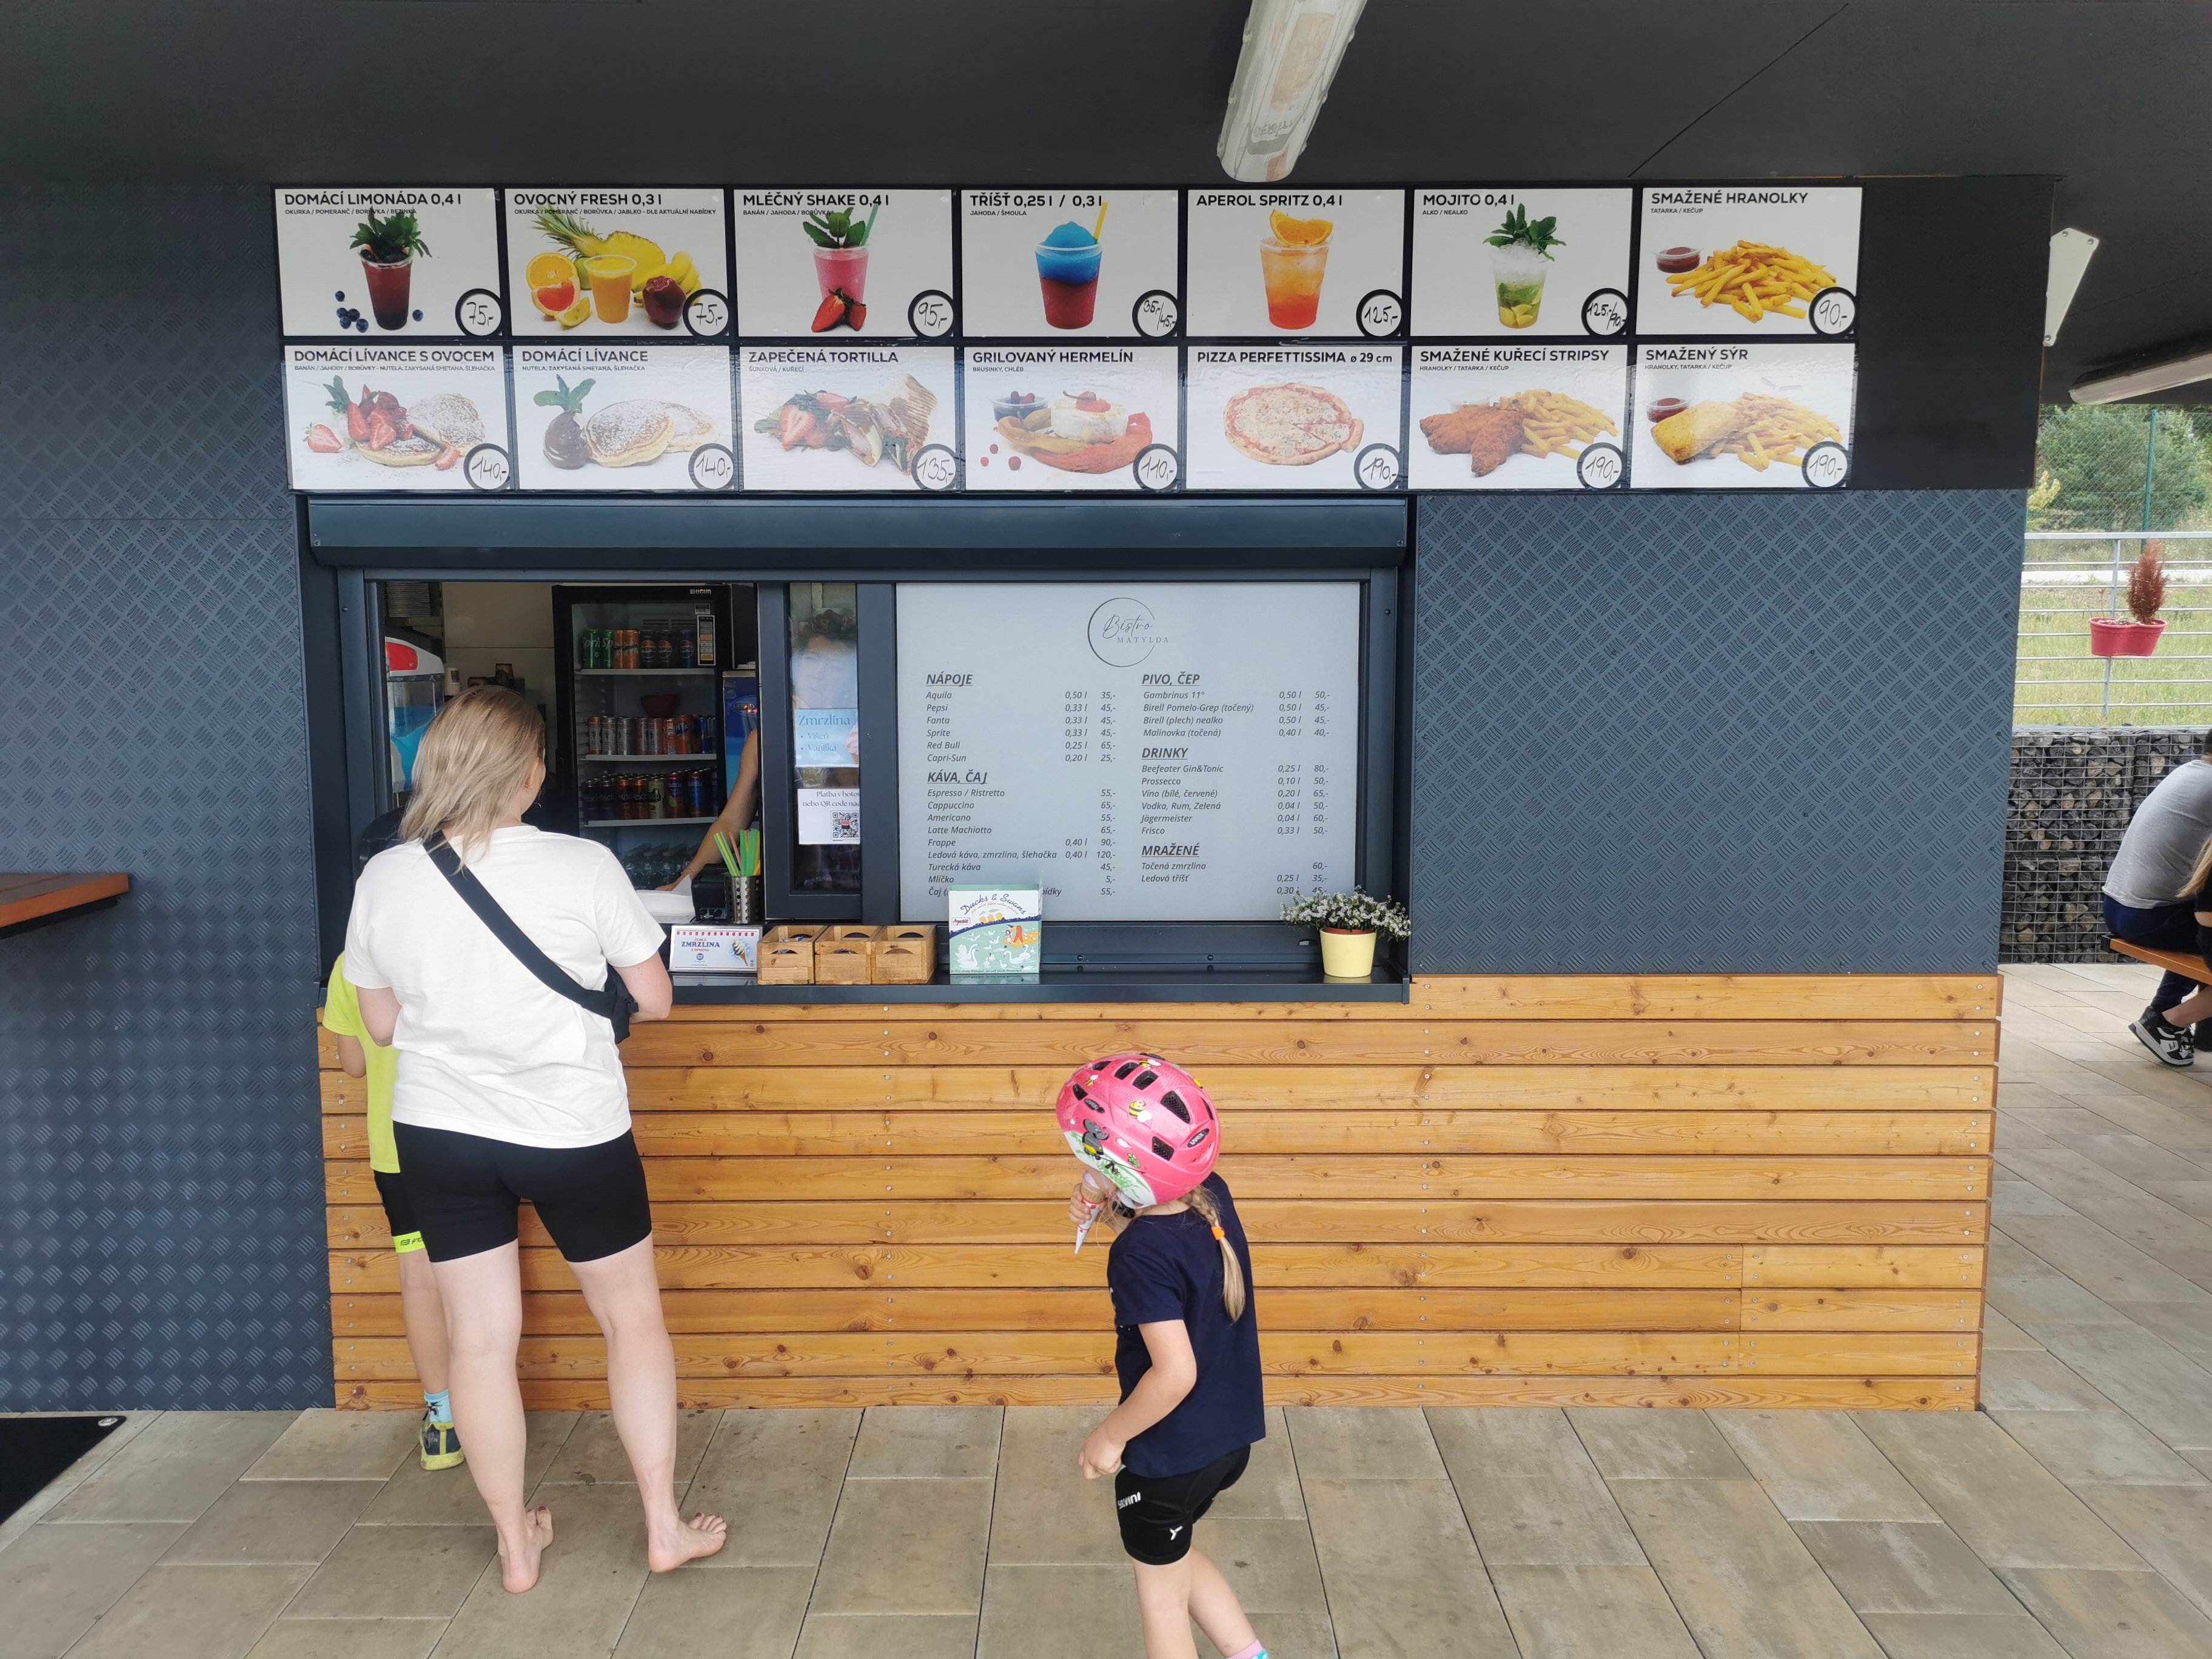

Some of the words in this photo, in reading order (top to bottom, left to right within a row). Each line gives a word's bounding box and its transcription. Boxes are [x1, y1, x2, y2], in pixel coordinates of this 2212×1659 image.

[284, 191, 343, 205] DOMÁCÍ
[348, 190, 428, 205] LIMONÁDA
[431, 193, 454, 206] 0,4
[514, 191, 577, 205] OVOCNÝ
[581, 194, 628, 205] FRESH
[632, 194, 655, 207] 0,3
[743, 192, 803, 206] MLÉČNÝ
[806, 194, 856, 207] SHAKE
[859, 194, 882, 207] 0,4
[970, 192, 1010, 206] TŘÍŠŤ
[1014, 195, 1045, 208] 0,25
[1072, 195, 1095, 208] 0,3
[1196, 195, 1256, 206] APEROL
[1259, 195, 1309, 206] SPRITZ
[1313, 195, 1335, 207] 0,4
[1424, 194, 1481, 206] MOJITO
[1484, 194, 1507, 207] 0,4
[1652, 190, 1722, 204] SMAŽENÉ
[1726, 193, 1808, 204] HRANOLKY
[545, 207, 578, 216] POMERANČ
[295, 348, 352, 361] DOMÁCÍ
[356, 348, 416, 361] LÍVANCE
[420, 350, 428, 361] S
[432, 350, 494, 362] OVOCEM
[522, 348, 582, 361] DOMÁCÍ
[586, 348, 648, 361] LÍVANCE
[749, 349, 827, 363] ZAPEČENÁ
[829, 352, 899, 363] TORTILLA
[973, 349, 1056, 363] GRILOVANÝ
[1060, 349, 1133, 363] HERMELÍN
[1198, 352, 1237, 363] PIZZA
[1240, 352, 1346, 363] PERFETTISSIMA
[1359, 352, 1373, 363] 29
[1420, 348, 1490, 362] SMAŽENÉ
[1494, 347, 1546, 361] KUŘECÍ
[1550, 350, 1609, 361] STRIPSY
[1646, 346, 1717, 360] SMAŽENÝ
[1720, 346, 1748, 360] SÝR
[926, 671, 973, 686] NÁPOJE
[1142, 674, 1173, 686] PIVO,
[1178, 672, 1200, 685] ČEP
[925, 691, 952, 701] Aquila
[1065, 691, 1082, 700] 0,50
[1100, 691, 1116, 700] 35,-
[1279, 691, 1296, 700] 0,50
[1315, 691, 1330, 700] 50,-
[927, 703, 948, 714] Pepsi
[1144, 703, 1164, 712] Birell
[1167, 703, 1219, 714] Pomelo-Grep
[1221, 703, 1254, 713] (točený)
[799, 714, 850, 725] Zmrzlina
[1167, 716, 1193, 726] (plech)
[927, 729, 951, 739] Sprite
[1188, 729, 1221, 738] (točená)
[1278, 729, 1296, 737] 0,40
[1313, 729, 1329, 737] 40,-
[945, 741, 960, 749] Bull
[1065, 741, 1082, 750] 0,25
[1101, 741, 1116, 750] 65,-
[927, 754, 967, 764] Capri-Sun
[1141, 748, 1188, 759] DRINKY
[1142, 765, 1181, 775] Beefeater
[927, 769, 961, 783] KÁVA,
[965, 769, 988, 785] ČAJ
[928, 789, 962, 799] Espresso
[1162, 789, 1181, 799] (bílé,
[1184, 789, 1218, 799] červené)
[928, 801, 974, 811] Cappuccino
[1142, 802, 1168, 811] Vodka,
[1171, 802, 1191, 811] Rum,
[1141, 814, 1193, 824] Jägermeister
[928, 826, 948, 834] Latte
[928, 839, 956, 848] Frappe
[959, 851, 980, 859] káva,
[982, 851, 1019, 859] zmrzlina,
[1021, 850, 1057, 859] šlehačka
[1141, 843, 1199, 856] MRAŽENÉ
[928, 876, 954, 884] Mlíčko
[929, 887, 943, 897] Čaj
[960, 894, 988, 915] Ducks
[1000, 894, 1026, 914] Swans
